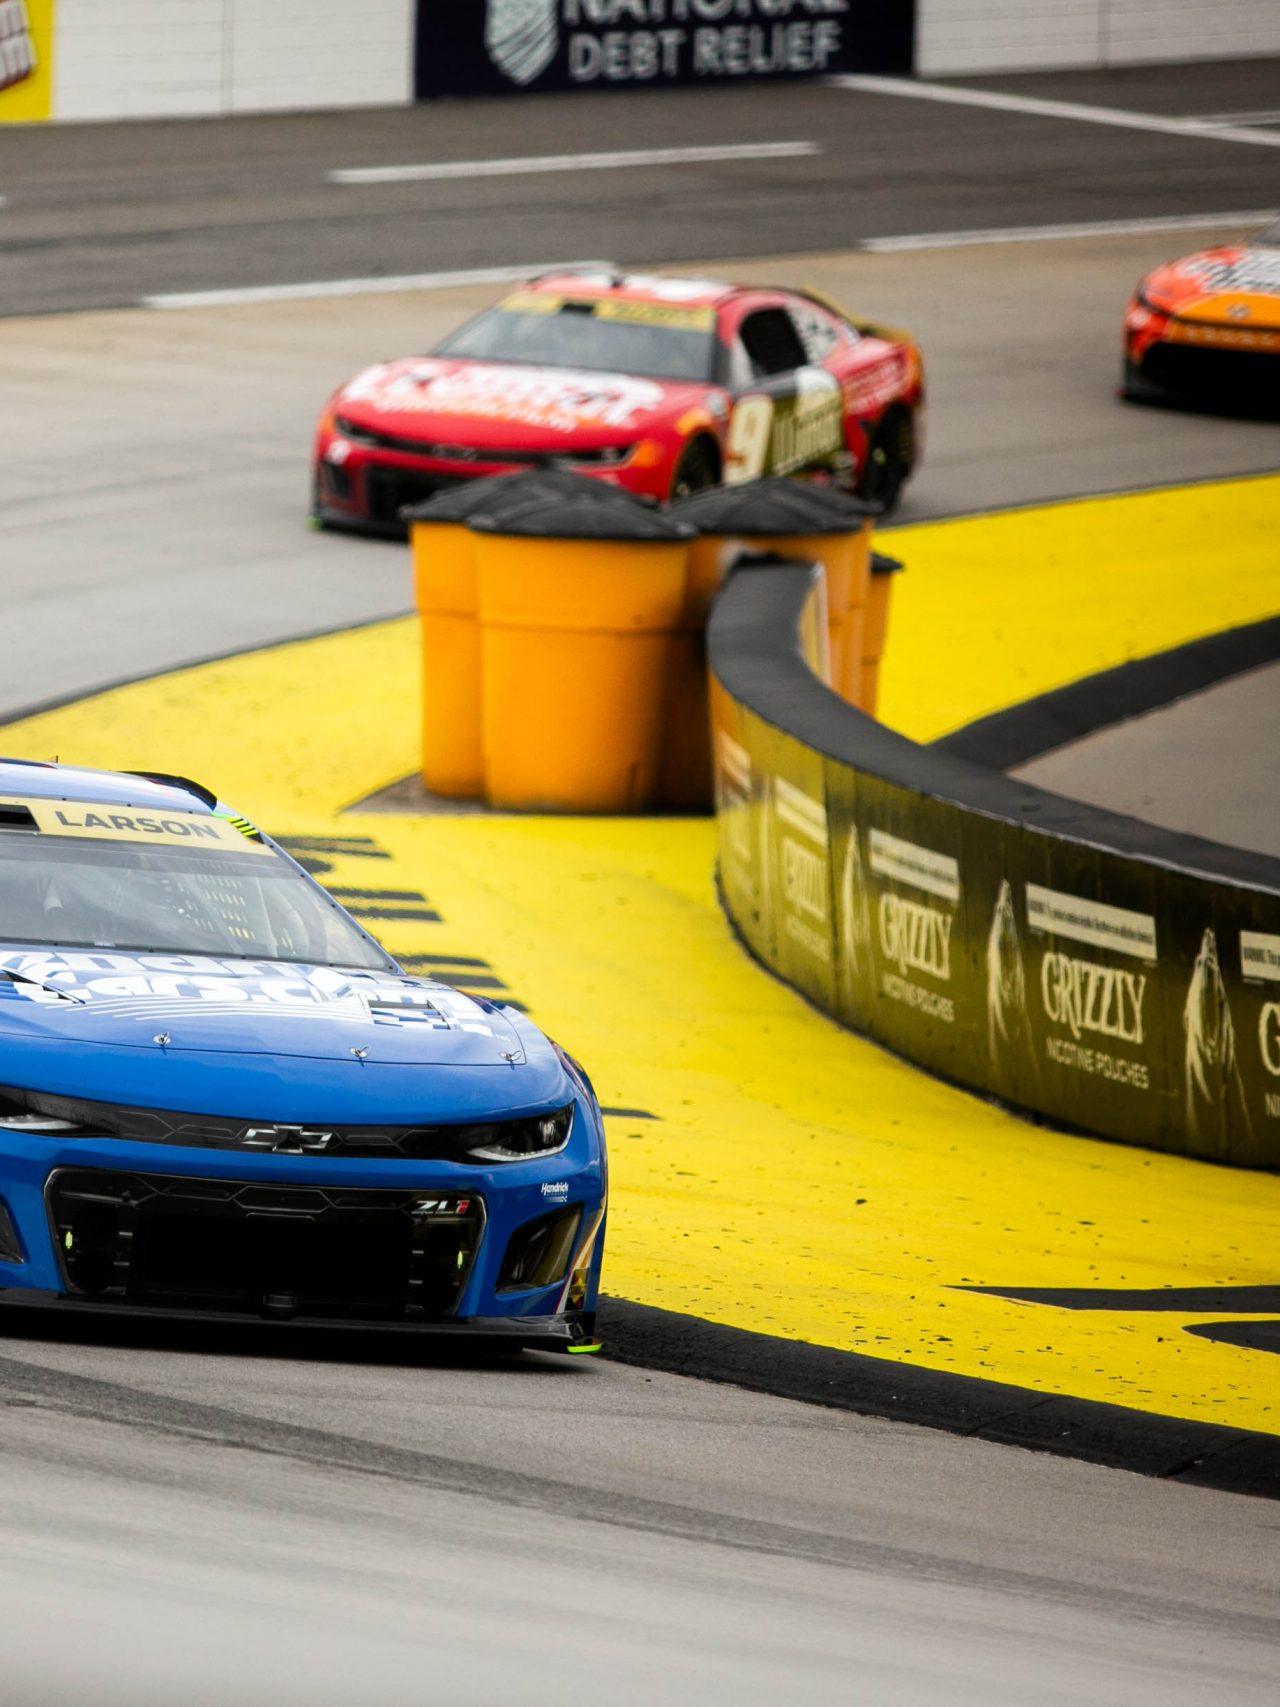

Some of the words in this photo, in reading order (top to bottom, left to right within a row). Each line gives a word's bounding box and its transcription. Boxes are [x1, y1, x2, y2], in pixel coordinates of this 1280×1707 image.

[570, 31, 686, 81] DEBT
[694, 20, 841, 75] RELIEF
[724, 394, 773, 486] 9
[54, 810, 222, 840] LARSON
[879, 892, 953, 980] GRIZZLY
[1040, 951, 1147, 1046] GRIZZLY
[1046, 1035, 1095, 1072] NICOTINE
[1094, 1050, 1151, 1091] POUCHES
[411, 1199, 471, 1215] ZL1
[541, 1181, 569, 1196] Hendrick
